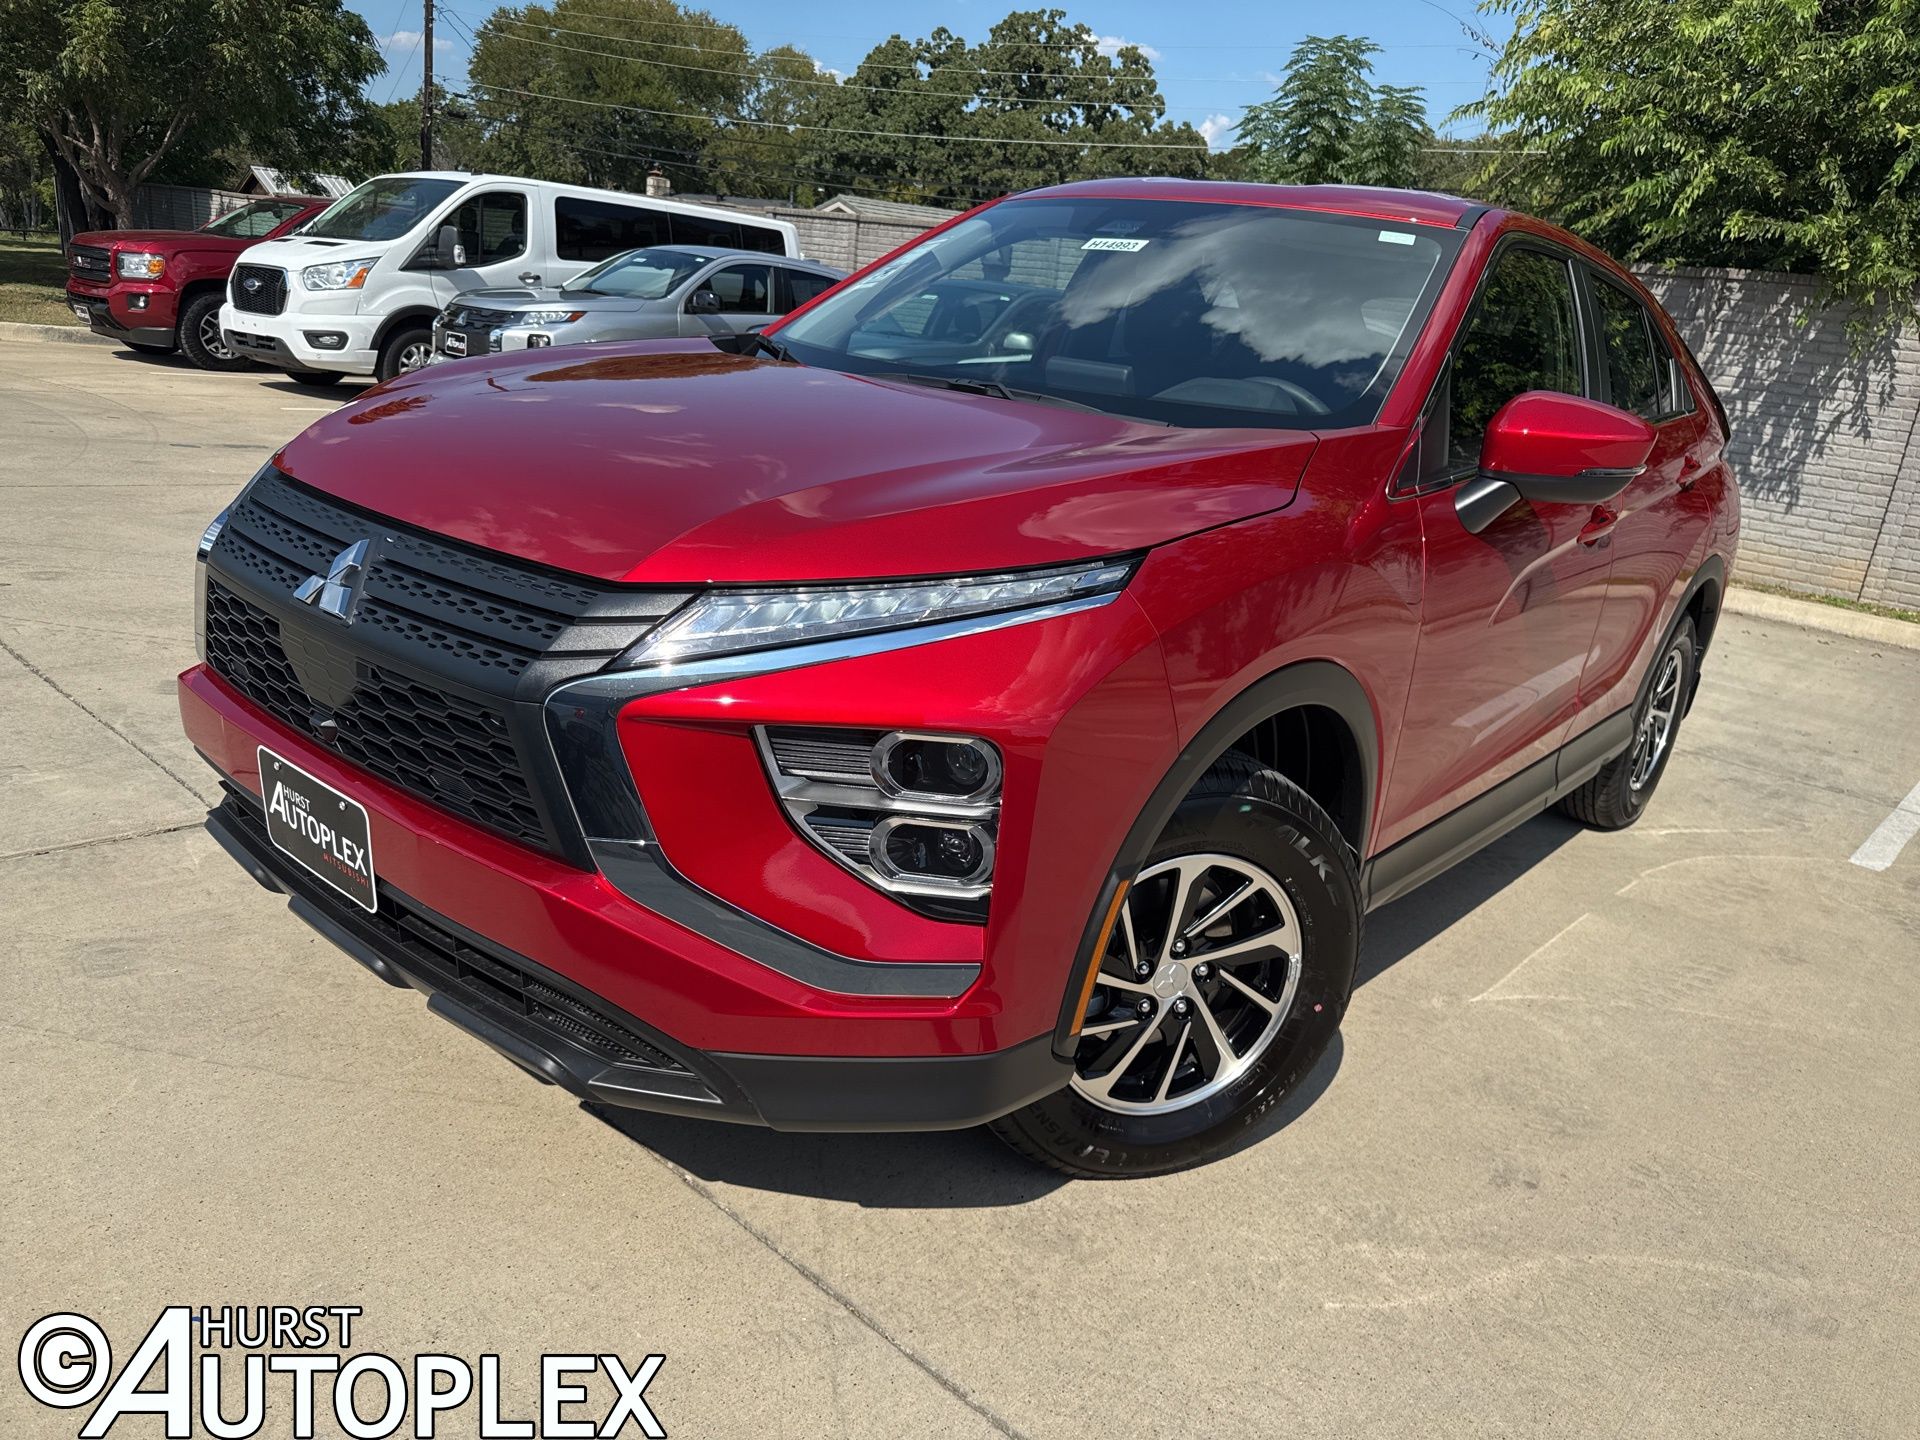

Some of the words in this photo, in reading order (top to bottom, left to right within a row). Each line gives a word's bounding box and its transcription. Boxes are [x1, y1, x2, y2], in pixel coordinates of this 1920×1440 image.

[284, 785, 310, 811] HURST
[269, 781, 367, 876] AUTOPLEX
[324, 854, 369, 886] MITSUBISHI
